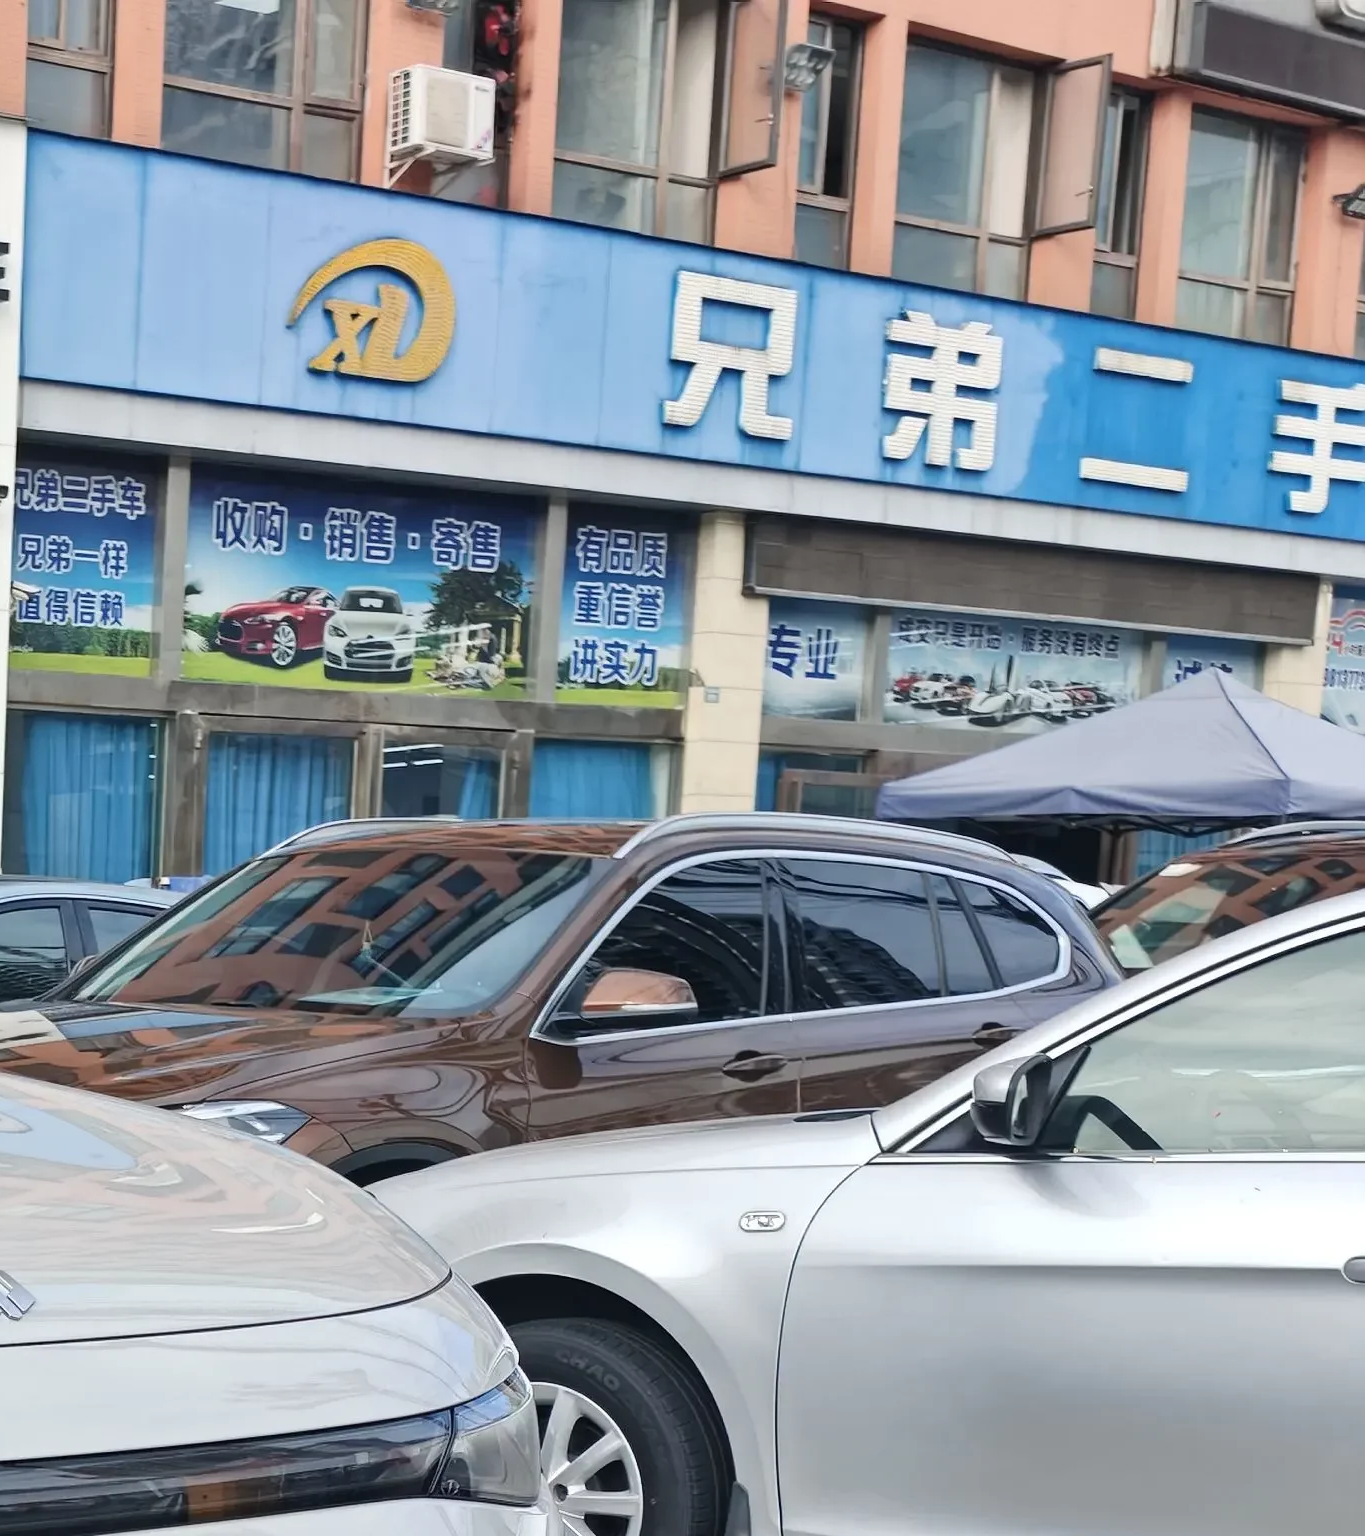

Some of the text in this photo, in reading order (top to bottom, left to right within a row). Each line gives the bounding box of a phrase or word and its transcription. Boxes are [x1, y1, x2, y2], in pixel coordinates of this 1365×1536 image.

[661, 268, 1365, 515] 兄弟二手
[17, 533, 128, 580] 兄弟一样
[575, 525, 668, 579] 有品质
[573, 581, 664, 632] 重信誉
[569, 637, 660, 687] 讲实力
[768, 624, 839, 680] 专业
